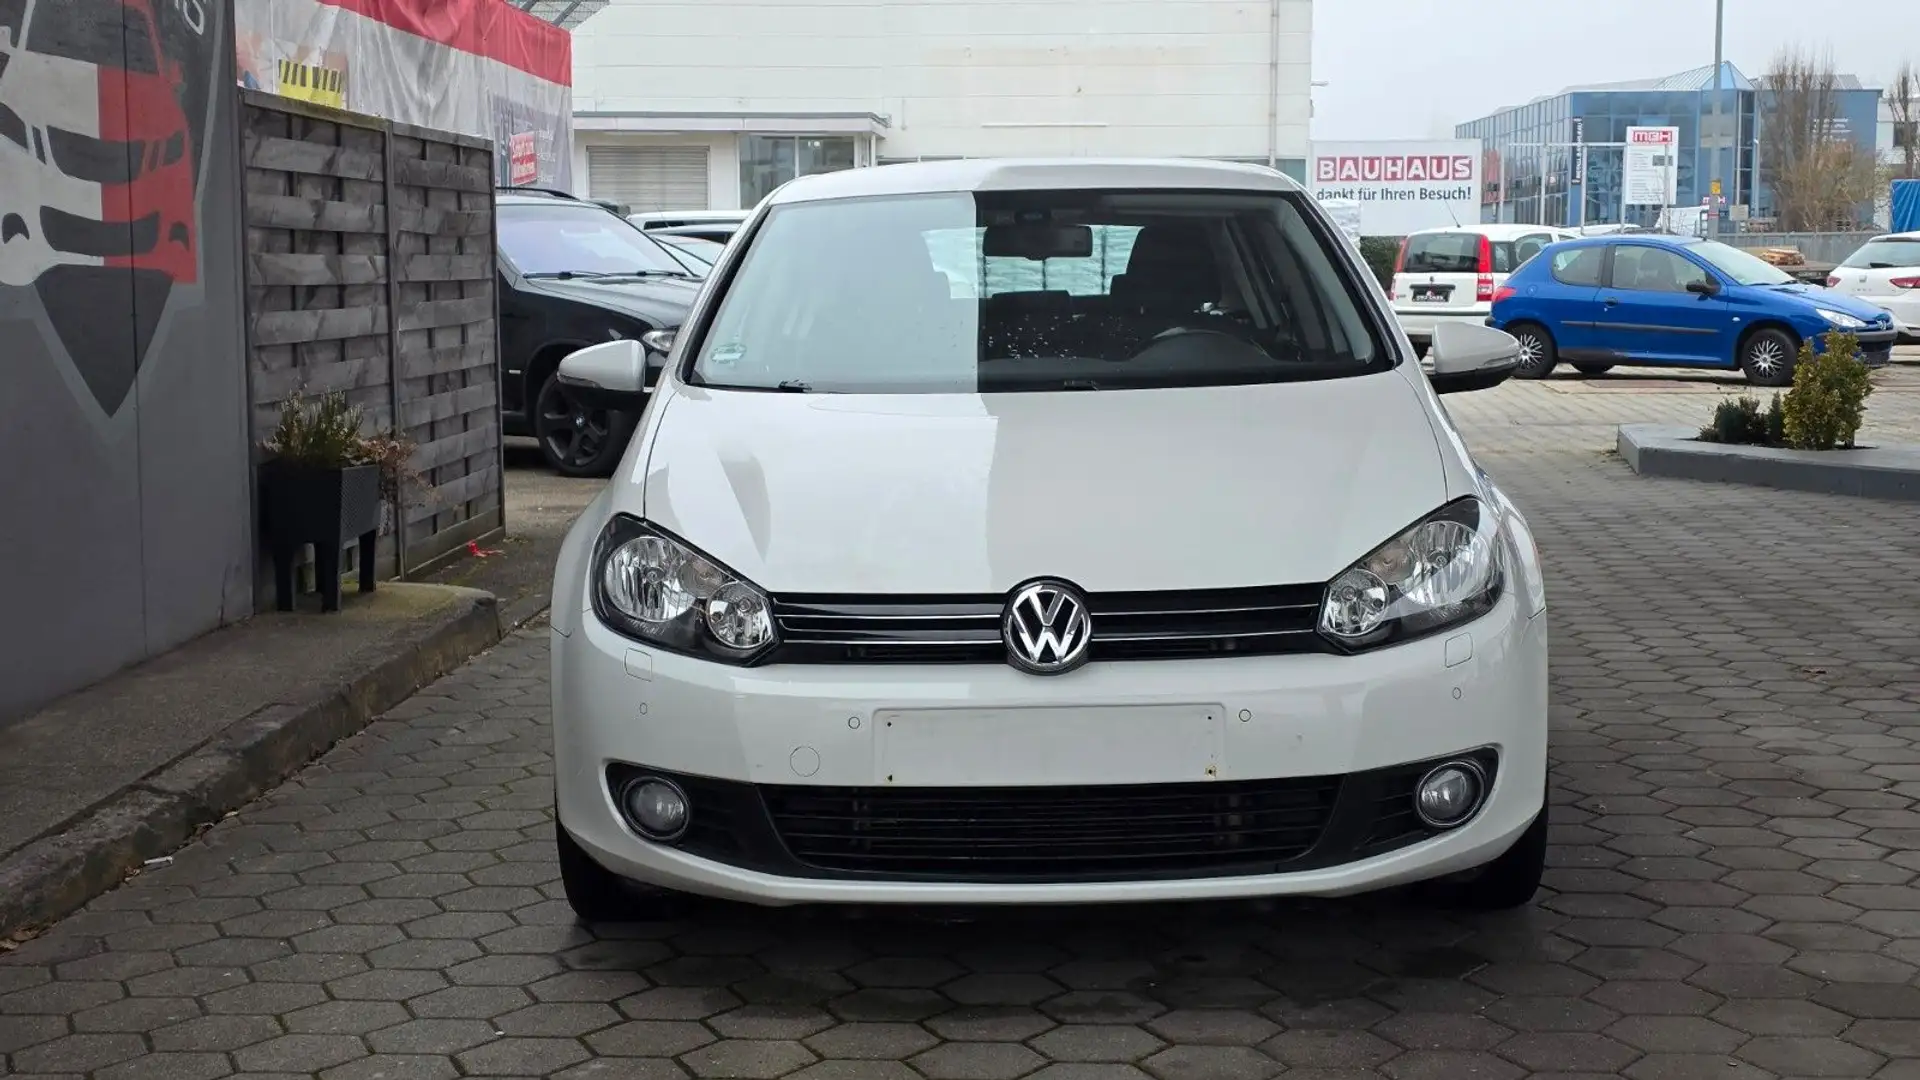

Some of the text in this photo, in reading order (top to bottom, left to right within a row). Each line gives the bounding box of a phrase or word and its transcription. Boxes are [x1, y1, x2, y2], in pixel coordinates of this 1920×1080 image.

[1317, 156, 1473, 181] BAUHAUS
[1316, 186, 1472, 201] dankt für Ihren Besuch!
